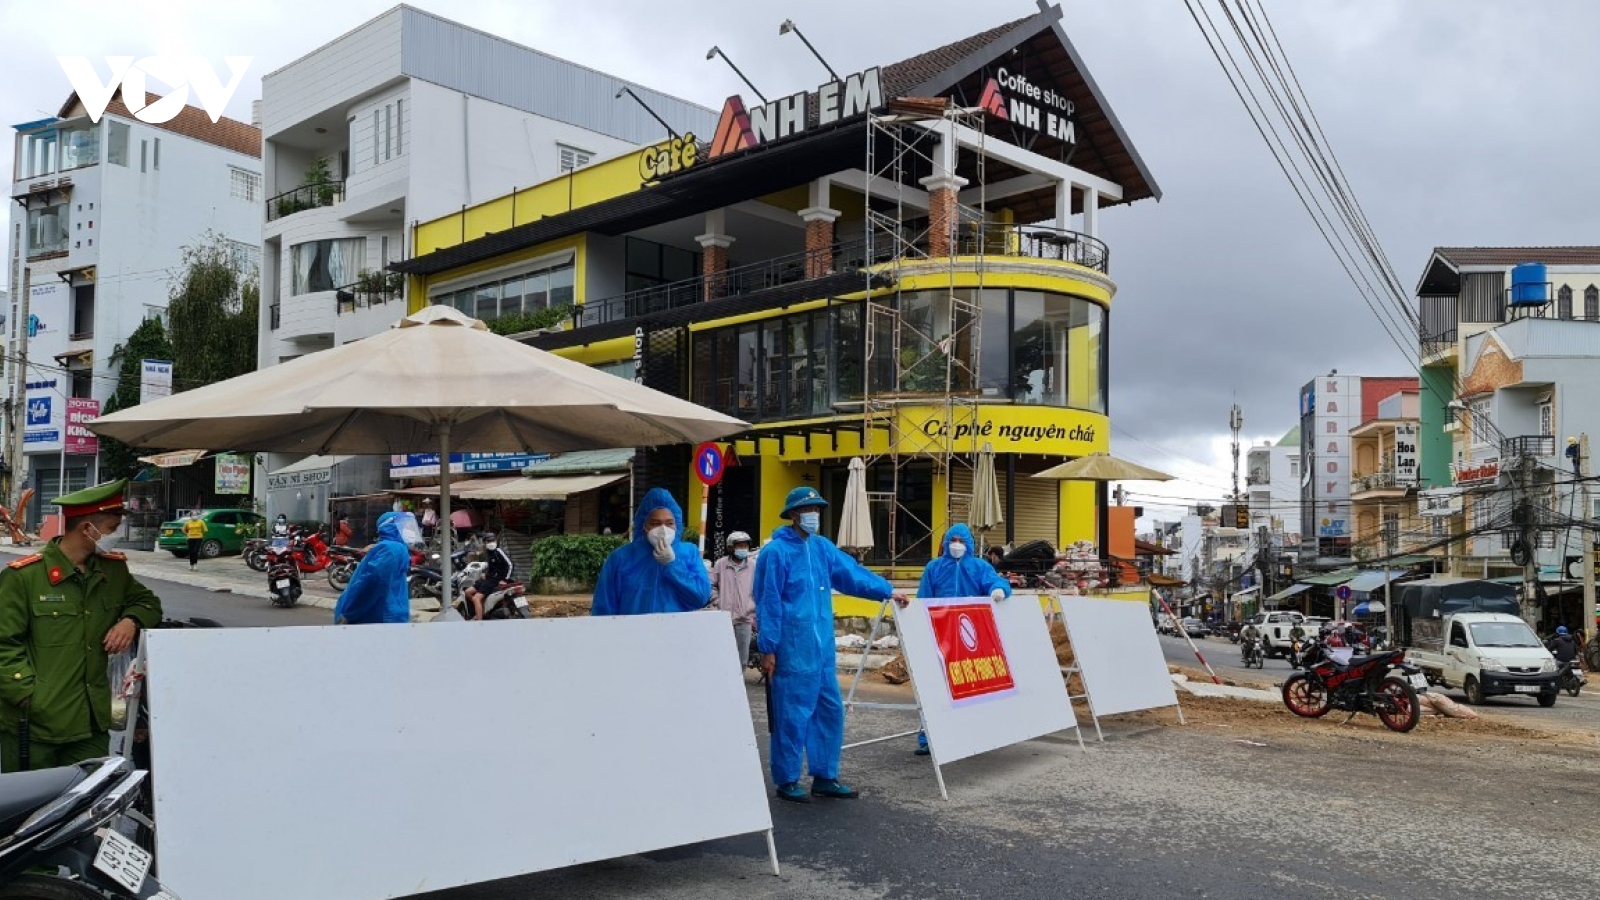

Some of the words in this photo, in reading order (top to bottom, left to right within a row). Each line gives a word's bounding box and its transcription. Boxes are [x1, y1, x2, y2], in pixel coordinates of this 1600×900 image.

[997, 67, 1041, 100] Coffee
[1043, 88, 1075, 116] shop
[639, 132, 697, 181] Café
[818, 66, 883, 126] EM
[1046, 111, 1076, 144] EM
[633, 327, 643, 369] shop
[953, 419, 993, 440] phê
[999, 423, 1066, 442] nguyên
[1069, 424, 1095, 443] chất
[1397, 441, 1416, 453] Hoa
[1397, 455, 1416, 467] Lan
[303, 471, 330, 482] SHOP
